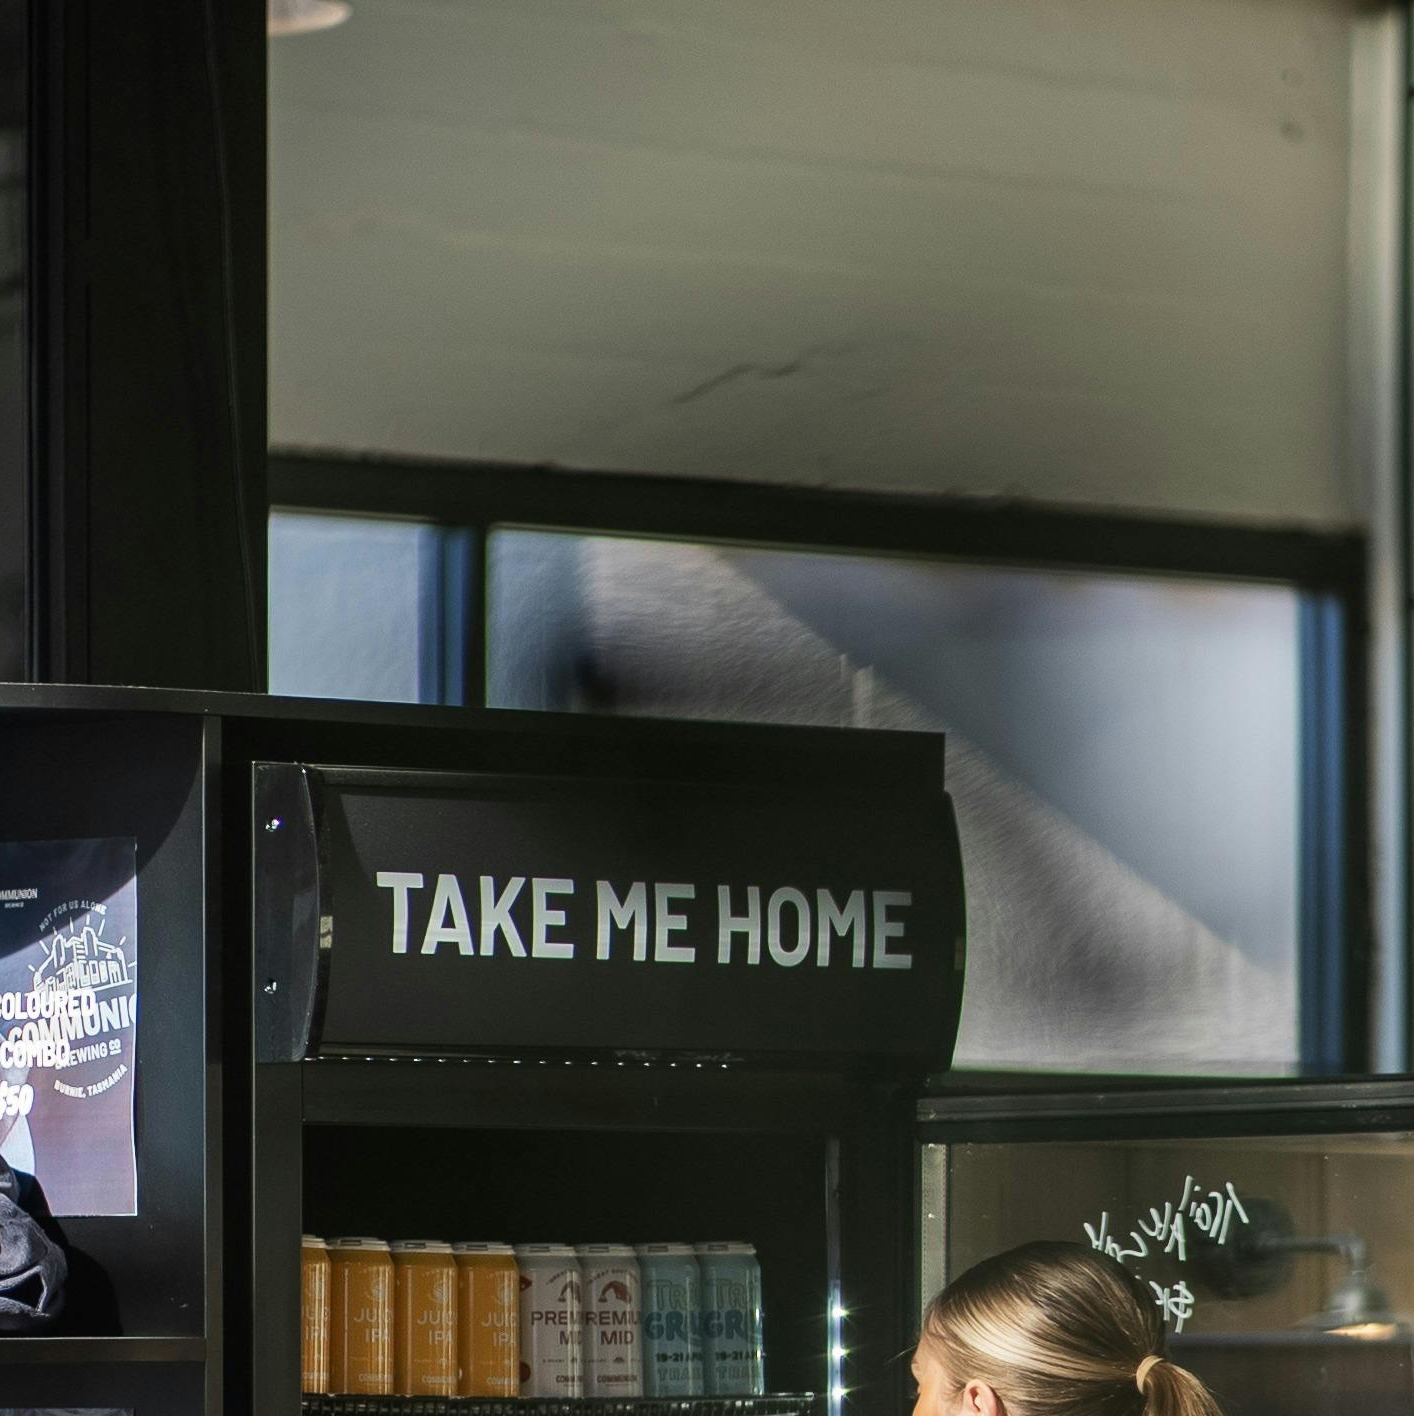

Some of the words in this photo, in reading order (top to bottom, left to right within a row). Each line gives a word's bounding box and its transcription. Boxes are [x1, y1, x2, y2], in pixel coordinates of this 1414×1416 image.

[38, 913, 53, 932] NOT
[53, 902, 67, 917] FOR
[68, 899, 79, 909] US
[376, 871, 574, 959] TAKE
[596, 879, 696, 964] ME
[717, 885, 912, 969] HOME
[0, 1041, 70, 1069] COMBO
[87, 1063, 128, 1096] TASMANIA
[600, 1331, 634, 1345] MID
